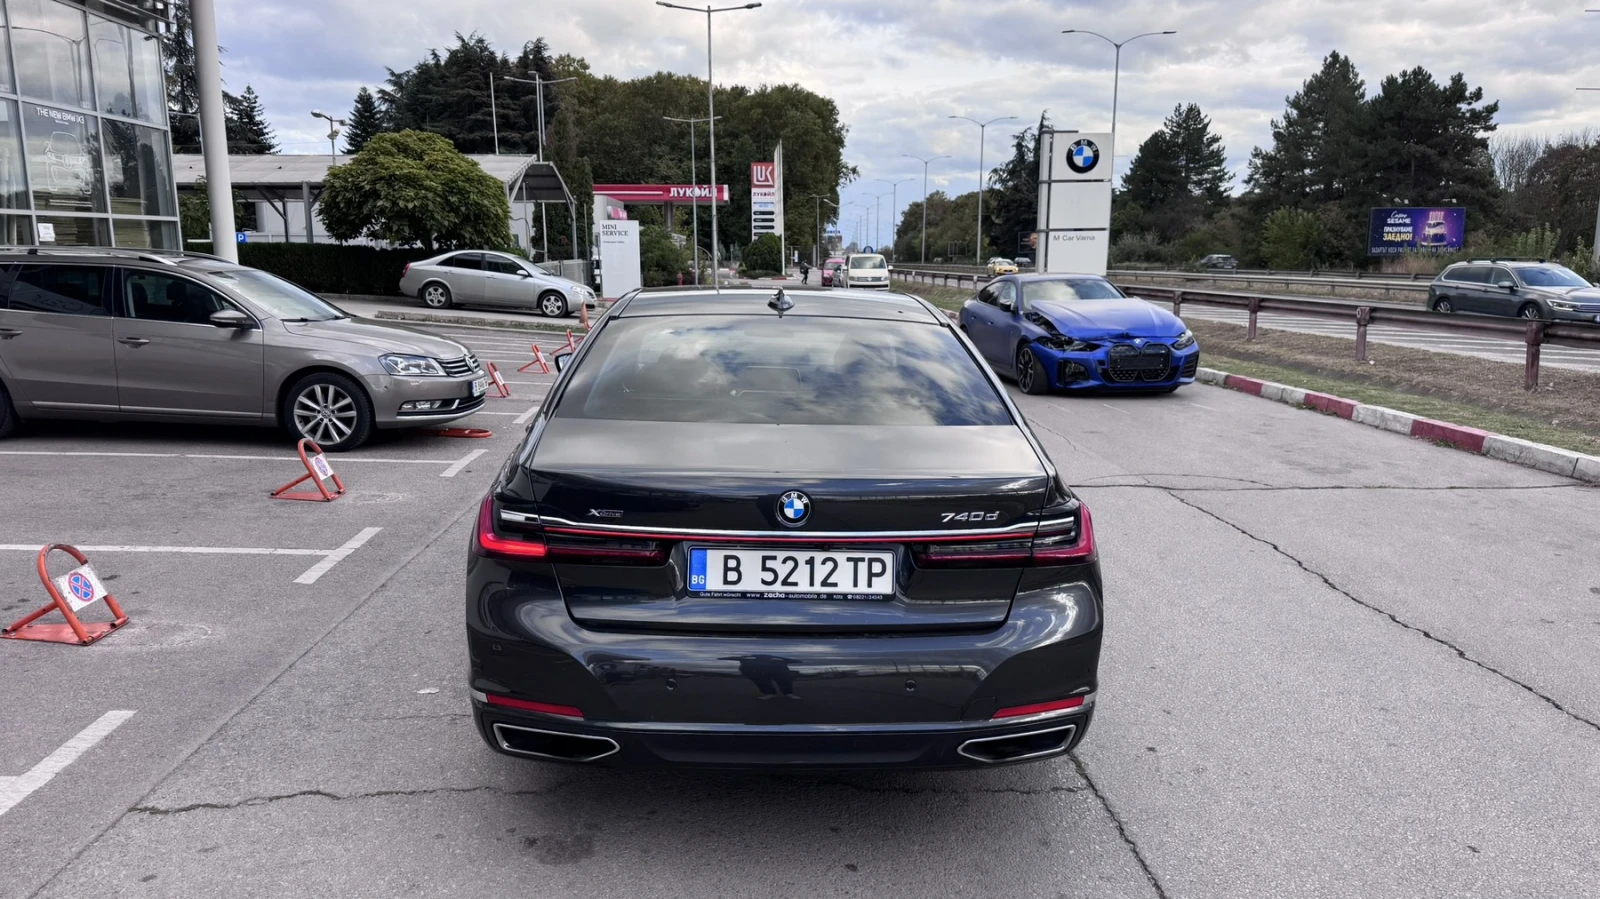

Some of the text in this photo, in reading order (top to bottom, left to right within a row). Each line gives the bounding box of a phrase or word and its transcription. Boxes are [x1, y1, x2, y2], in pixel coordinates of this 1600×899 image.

[36, 107, 49, 117] THE
[49, 109, 62, 120] NEW
[62, 112, 76, 122] BMW
[238, 233, 245, 242] P
[1383, 233, 1412, 242] ЗАЕДНО!
[941, 510, 1000, 523] 740d
[722, 554, 888, 589] B 5212 TP
[691, 574, 706, 585] BG
